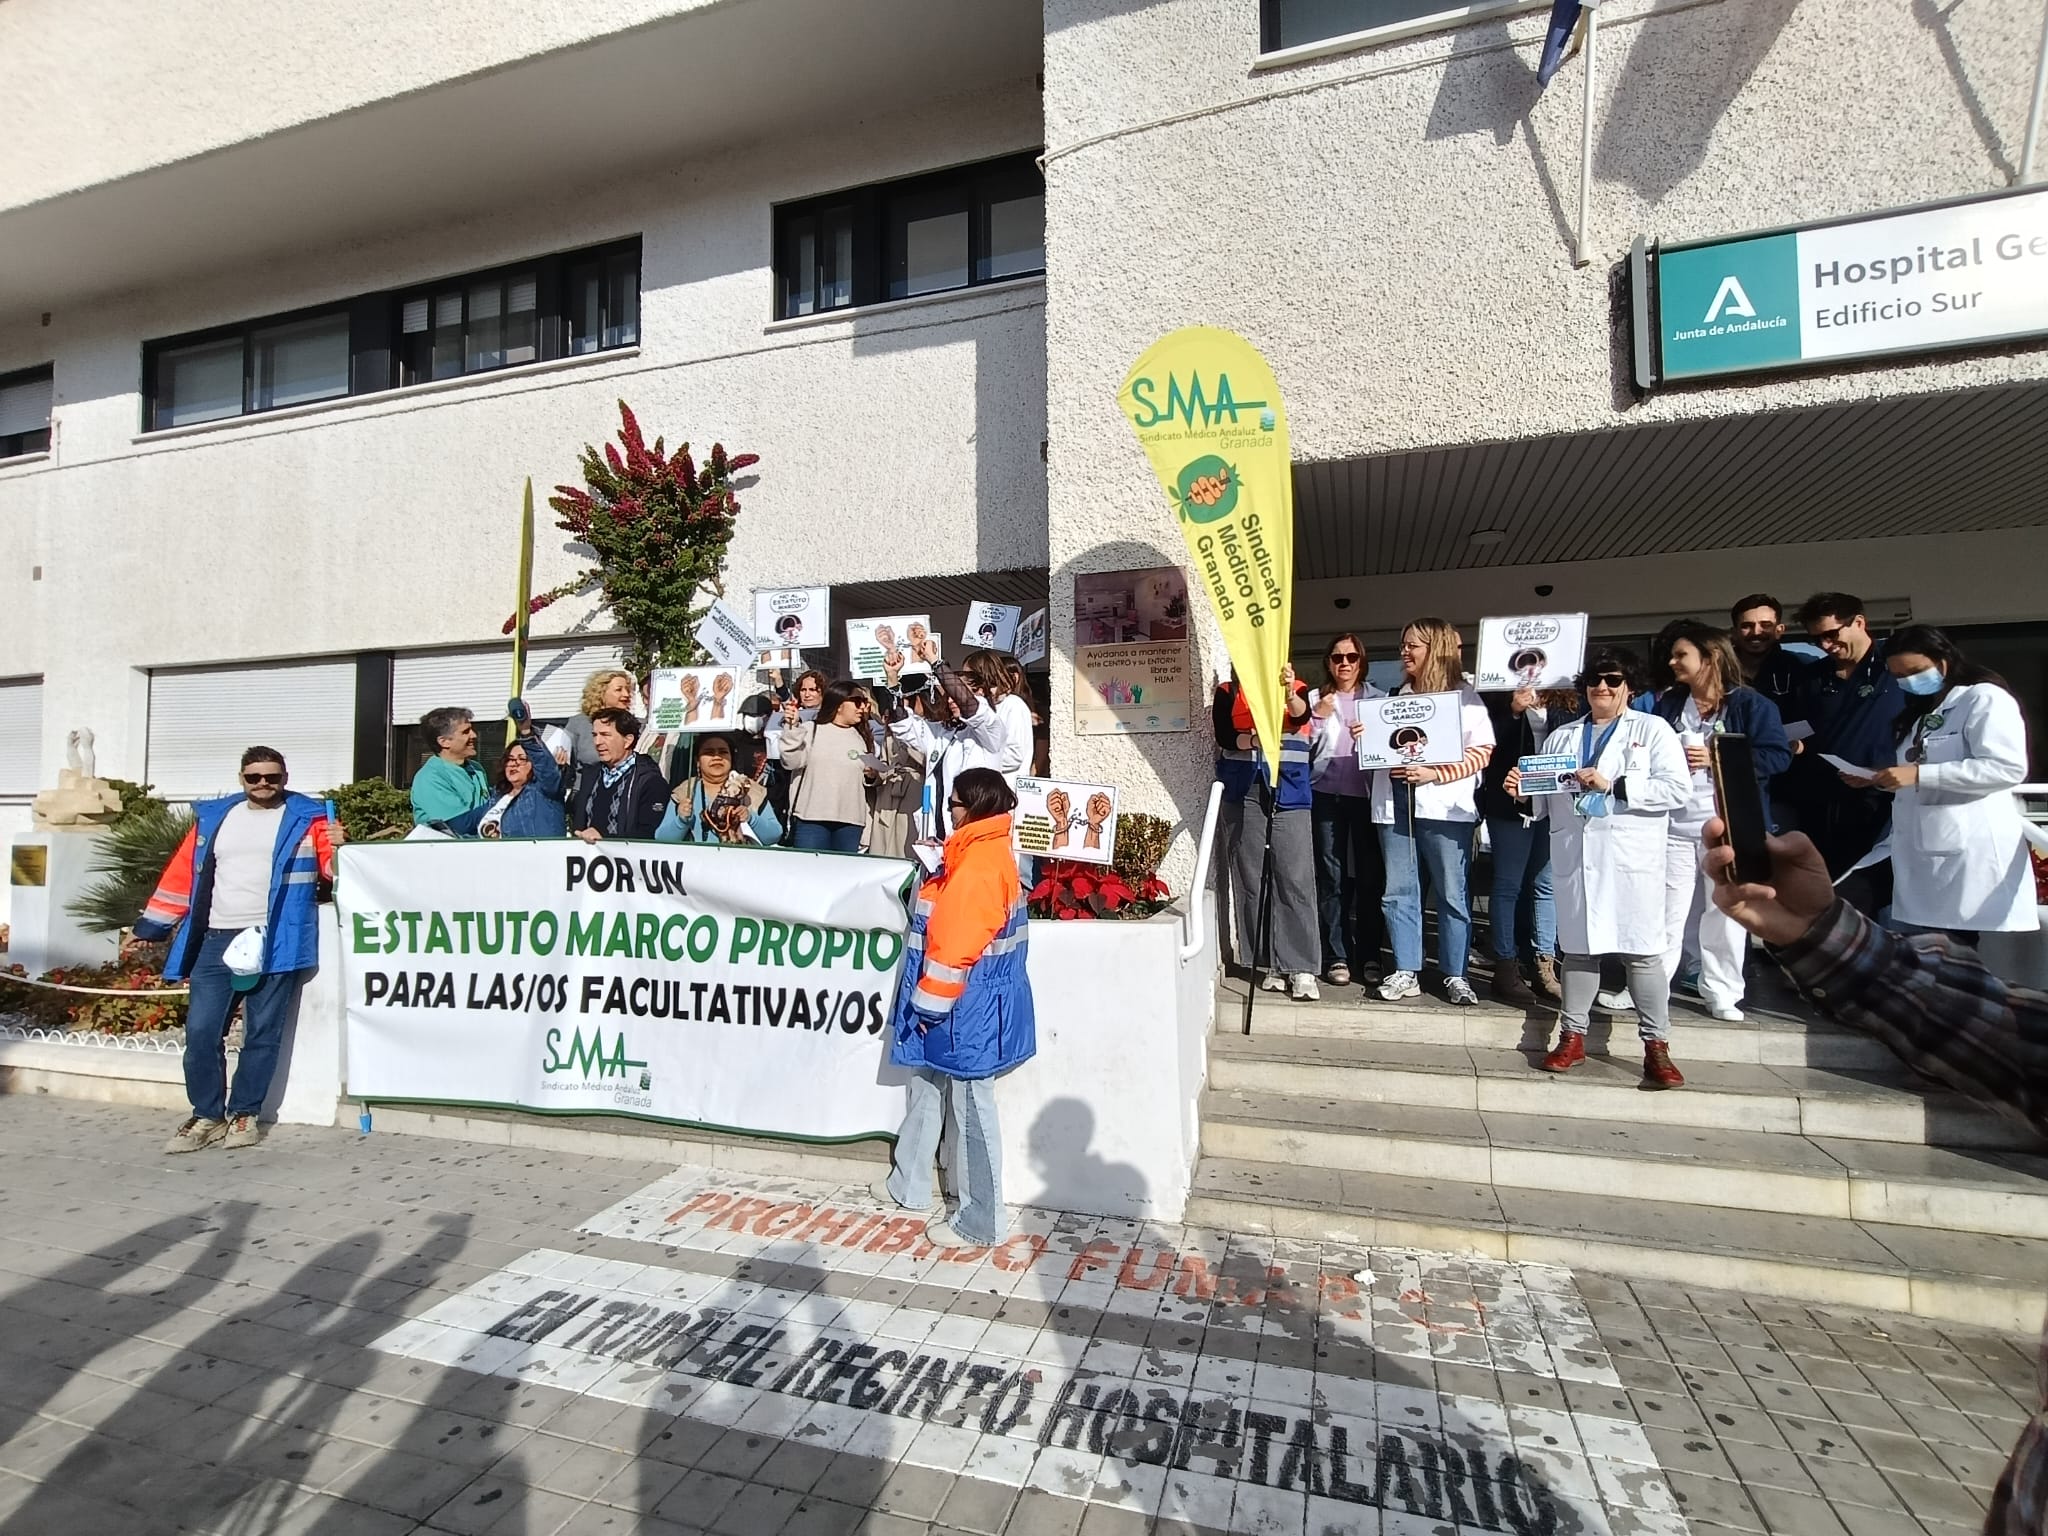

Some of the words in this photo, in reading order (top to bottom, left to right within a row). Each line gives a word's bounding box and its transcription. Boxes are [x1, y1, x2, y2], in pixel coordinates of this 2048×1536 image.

[1815, 238, 1982, 288] Hospital
[1673, 331, 1706, 341] Junta
[1709, 326, 1724, 335] de
[1726, 315, 1787, 334] Andalucía
[1816, 298, 1922, 329] Edificio
[1932, 291, 1983, 313] Sur
[1132, 369, 1267, 430] SMA
[1140, 433, 1182, 443] Sindicato
[1184, 430, 1217, 439] Médico
[1219, 427, 1256, 438] Andaluz
[1220, 436, 1273, 449] Granada
[1197, 535, 1235, 621] Granada
[1217, 524, 1253, 598] Médico
[1245, 602, 1265, 628] de
[1241, 513, 1282, 610] Sindicato
[1508, 626, 1556, 635] ESTATUTO
[1087, 651, 1129, 660] Ayúdanos
[1138, 648, 1181, 656] mantener
[1103, 659, 1130, 667] CENTRO
[1170, 666, 1181, 674] de
[1384, 705, 1432, 715] ESTATUTO
[566, 856, 635, 892] POR
[640, 859, 687, 896] UN
[353, 910, 558, 956] ESTATUTO
[565, 911, 719, 963] MARCO
[729, 917, 903, 972] PROPIO
[364, 971, 456, 1008] PARA
[466, 973, 568, 1013] LAS/OS
[580, 976, 884, 1035] FACULTATIVAS/OS
[543, 1025, 647, 1080] SMA
[541, 1081, 579, 1090] Sindicato
[582, 1082, 613, 1092] Médico
[614, 1083, 640, 1095] Andaluz
[614, 1092, 652, 1108] Granada
[665, 1192, 1047, 1271] PROHIBO
[485, 1290, 599, 1342] EN
